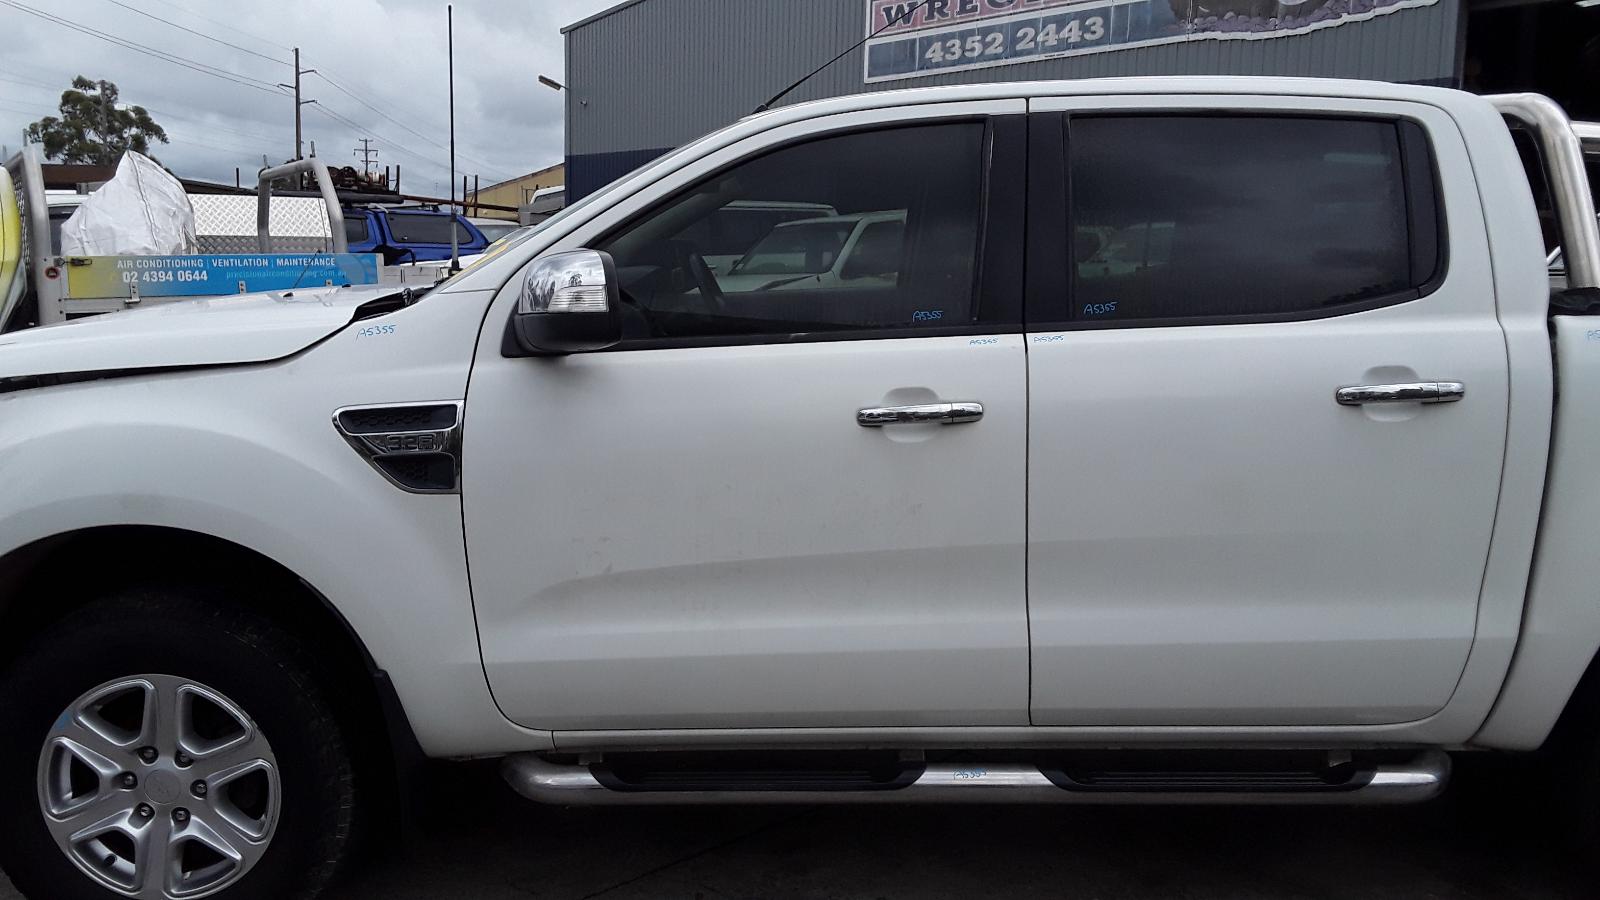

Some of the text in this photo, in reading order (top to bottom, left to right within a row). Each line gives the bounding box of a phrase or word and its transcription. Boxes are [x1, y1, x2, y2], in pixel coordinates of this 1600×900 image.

[924, 16, 1105, 63] 4352 2443
[117, 257, 336, 269] AIR CONDITIONING VENTILATION MAINTENANCE
[122, 269, 208, 283] 02 4394 0644
[356, 324, 397, 341] A5355
